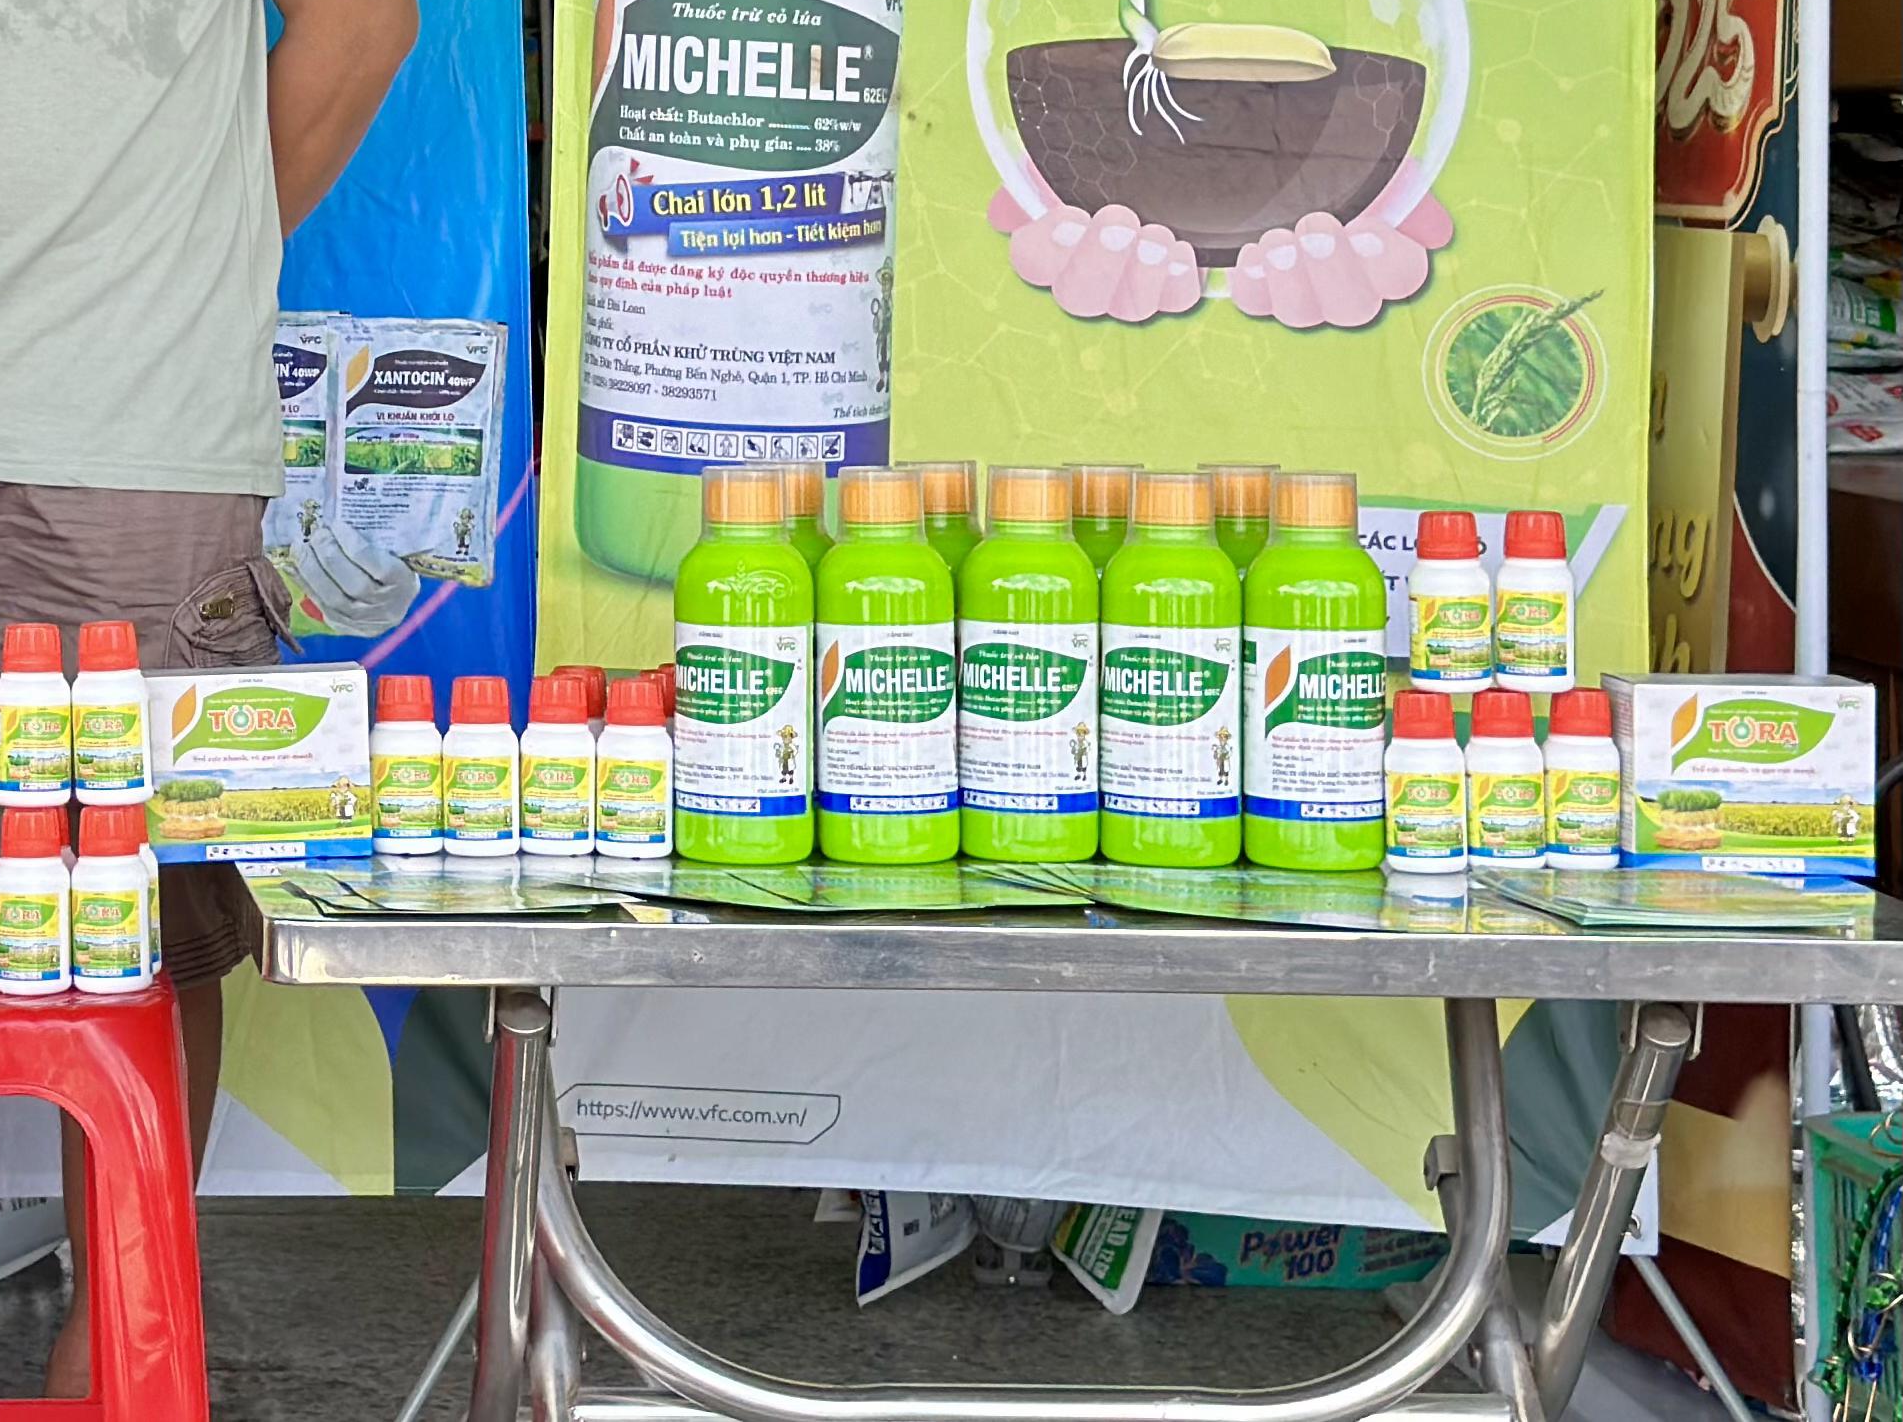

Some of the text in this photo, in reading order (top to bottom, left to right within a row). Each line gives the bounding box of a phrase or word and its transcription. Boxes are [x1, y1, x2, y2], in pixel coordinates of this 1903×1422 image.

[671, 1, 823, 27] Thuốc trừ cỏ lúa
[862, 86, 889, 105] 62EC
[619, 105, 646, 122] Hoạt
[687, 109, 765, 128] Butachlor
[619, 126, 841, 153] Chất an toàn và phụ gia: 38%
[653, 181, 827, 216] Chai lớn 1,2 lít
[680, 229, 719, 255] Tiện
[722, 229, 746, 251] lợi
[749, 227, 783, 245] hơn
[794, 222, 825, 243] Tiết
[828, 220, 862, 242] kiệm
[299, 335, 322, 345] VFC
[466, 345, 489, 355] VFC
[634, 337, 670, 358] PHẦN
[768, 348, 803, 367] VIỆT
[806, 351, 836, 364] NAM
[374, 370, 445, 386] XANTOCIN
[748, 371, 778, 386] Quận
[845, 665, 947, 695] MICHELLE
[963, 662, 1062, 693] MICHELLE
[1104, 666, 1204, 698] MICHELLE
[207, 704, 297, 736] TORA
[1707, 715, 1799, 748] TORA
[576, 1098, 808, 1128] https://www.vfc.com.vn/
